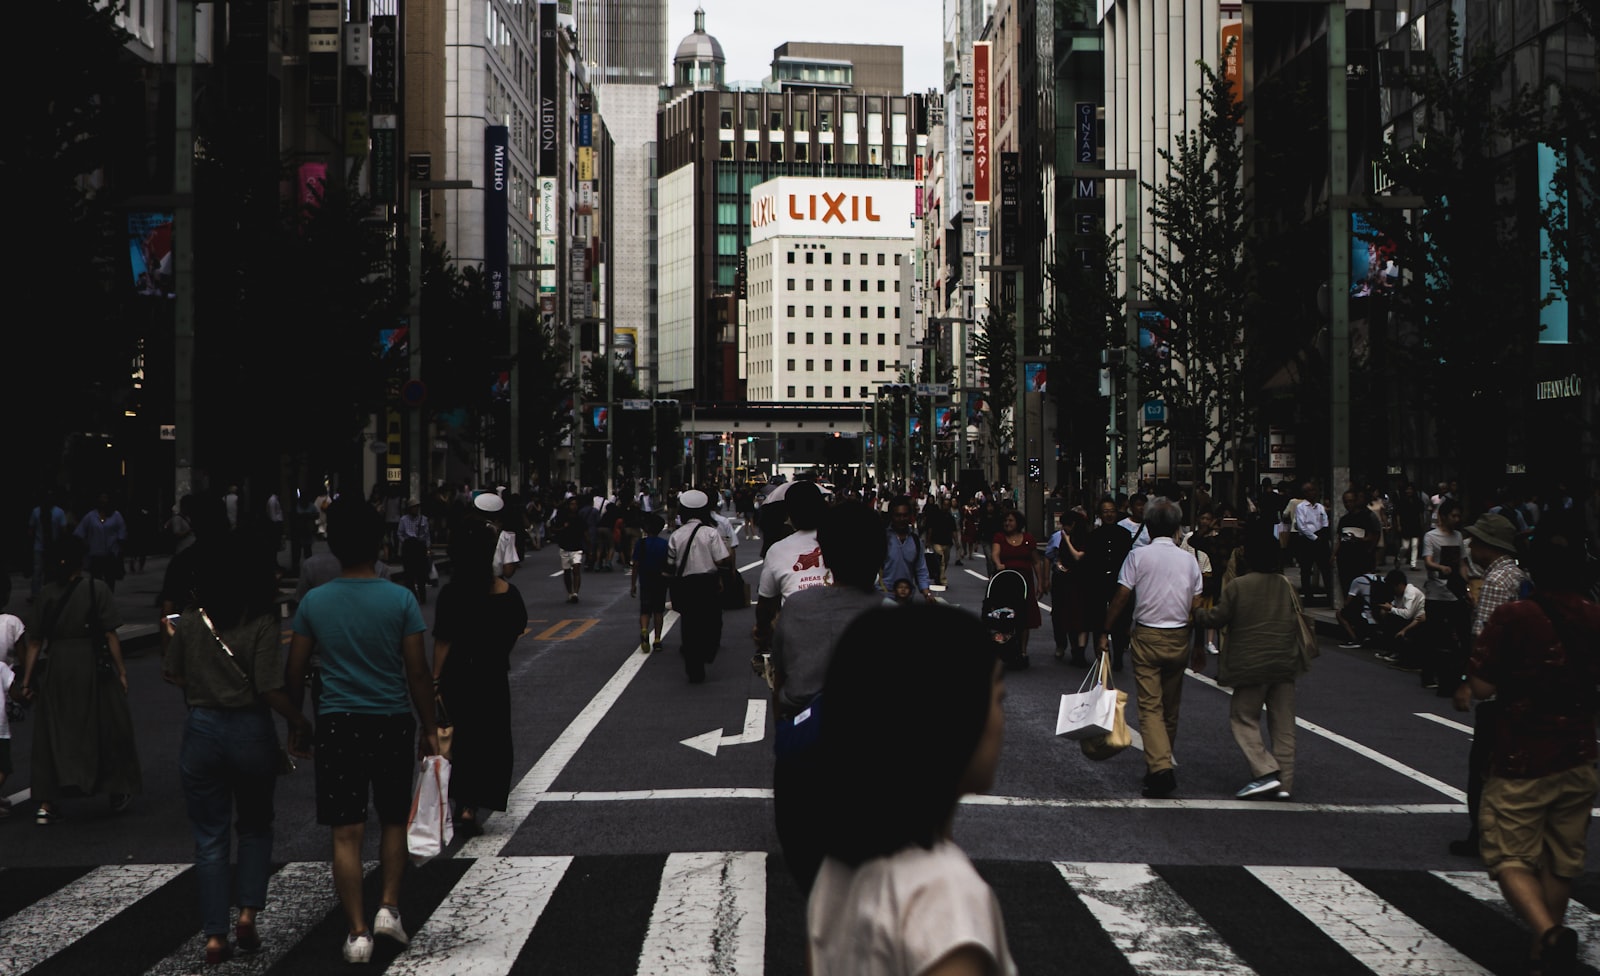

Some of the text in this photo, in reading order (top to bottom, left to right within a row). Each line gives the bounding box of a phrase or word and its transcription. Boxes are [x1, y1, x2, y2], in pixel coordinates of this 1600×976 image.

[542, 97, 554, 151] ALBION
[976, 105, 987, 179] 銀座アスター
[494, 145, 505, 191] MIZUHO
[752, 195, 777, 228] LIXIL
[789, 191, 881, 224] LIXIL
[492, 270, 503, 318] みずほ銀
